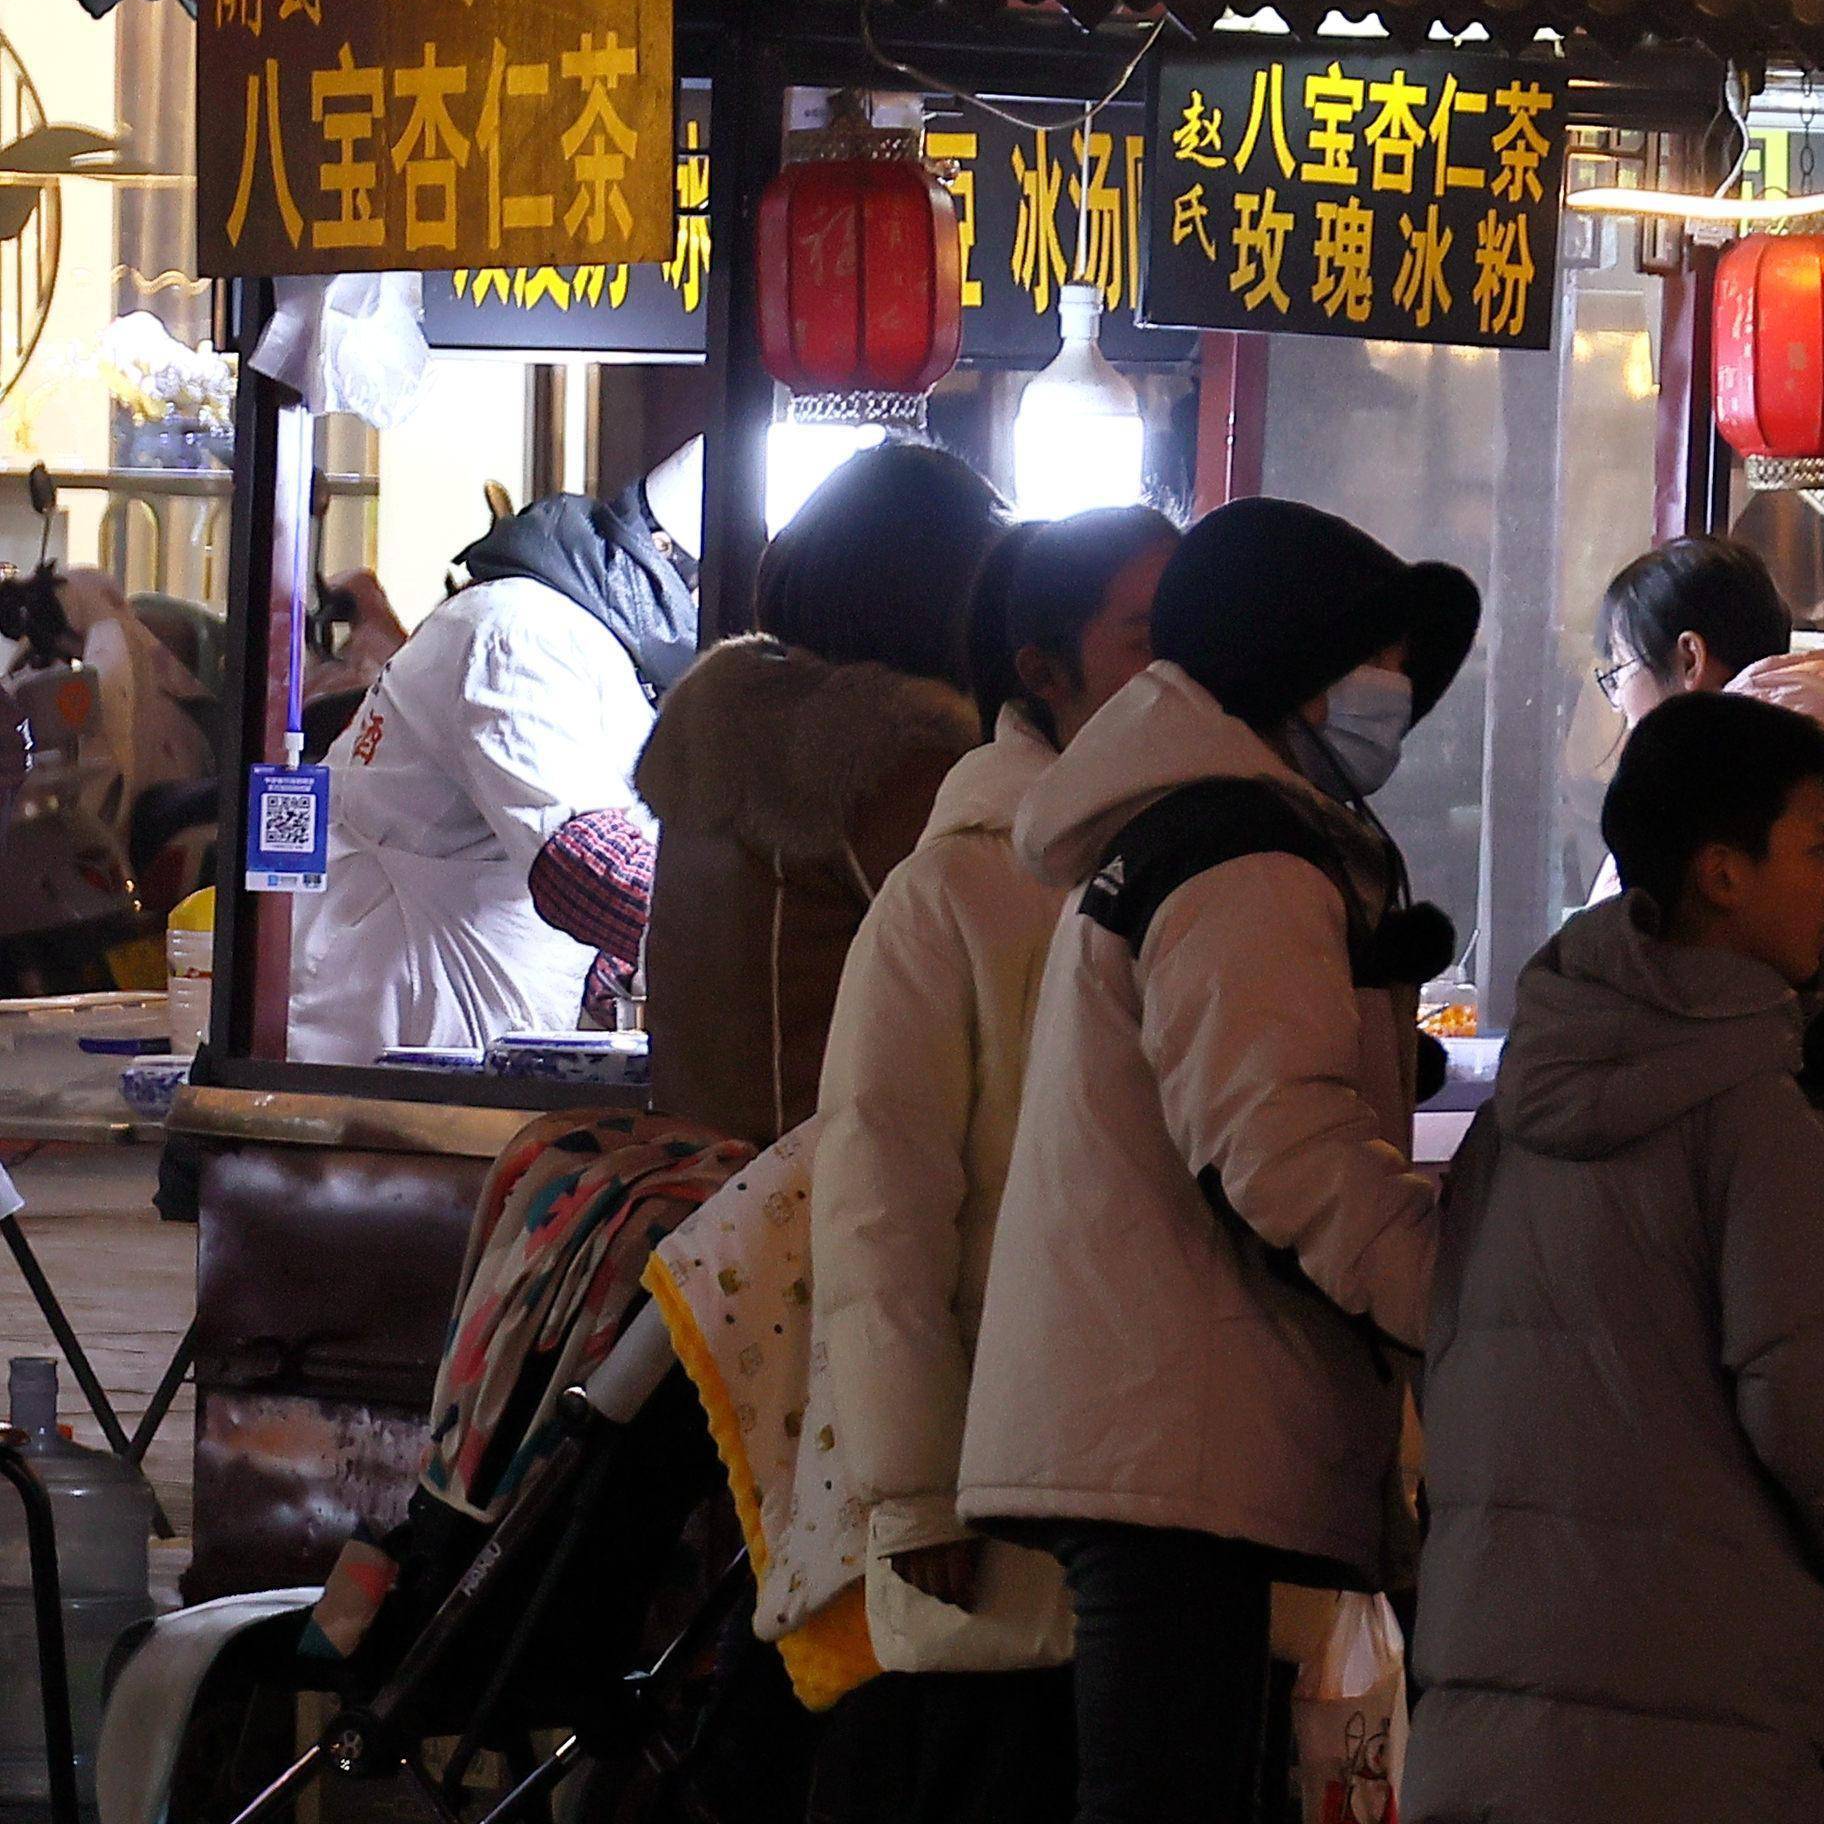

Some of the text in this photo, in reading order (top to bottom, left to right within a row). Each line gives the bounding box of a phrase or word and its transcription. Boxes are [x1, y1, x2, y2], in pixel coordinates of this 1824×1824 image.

[226, 30, 639, 252] 八宝杏仁茶
[1172, 90, 1228, 262] 赵氏
[1234, 62, 1554, 206] 八宝杏仁茶
[1228, 190, 1536, 336] 玫瑰冰粉
